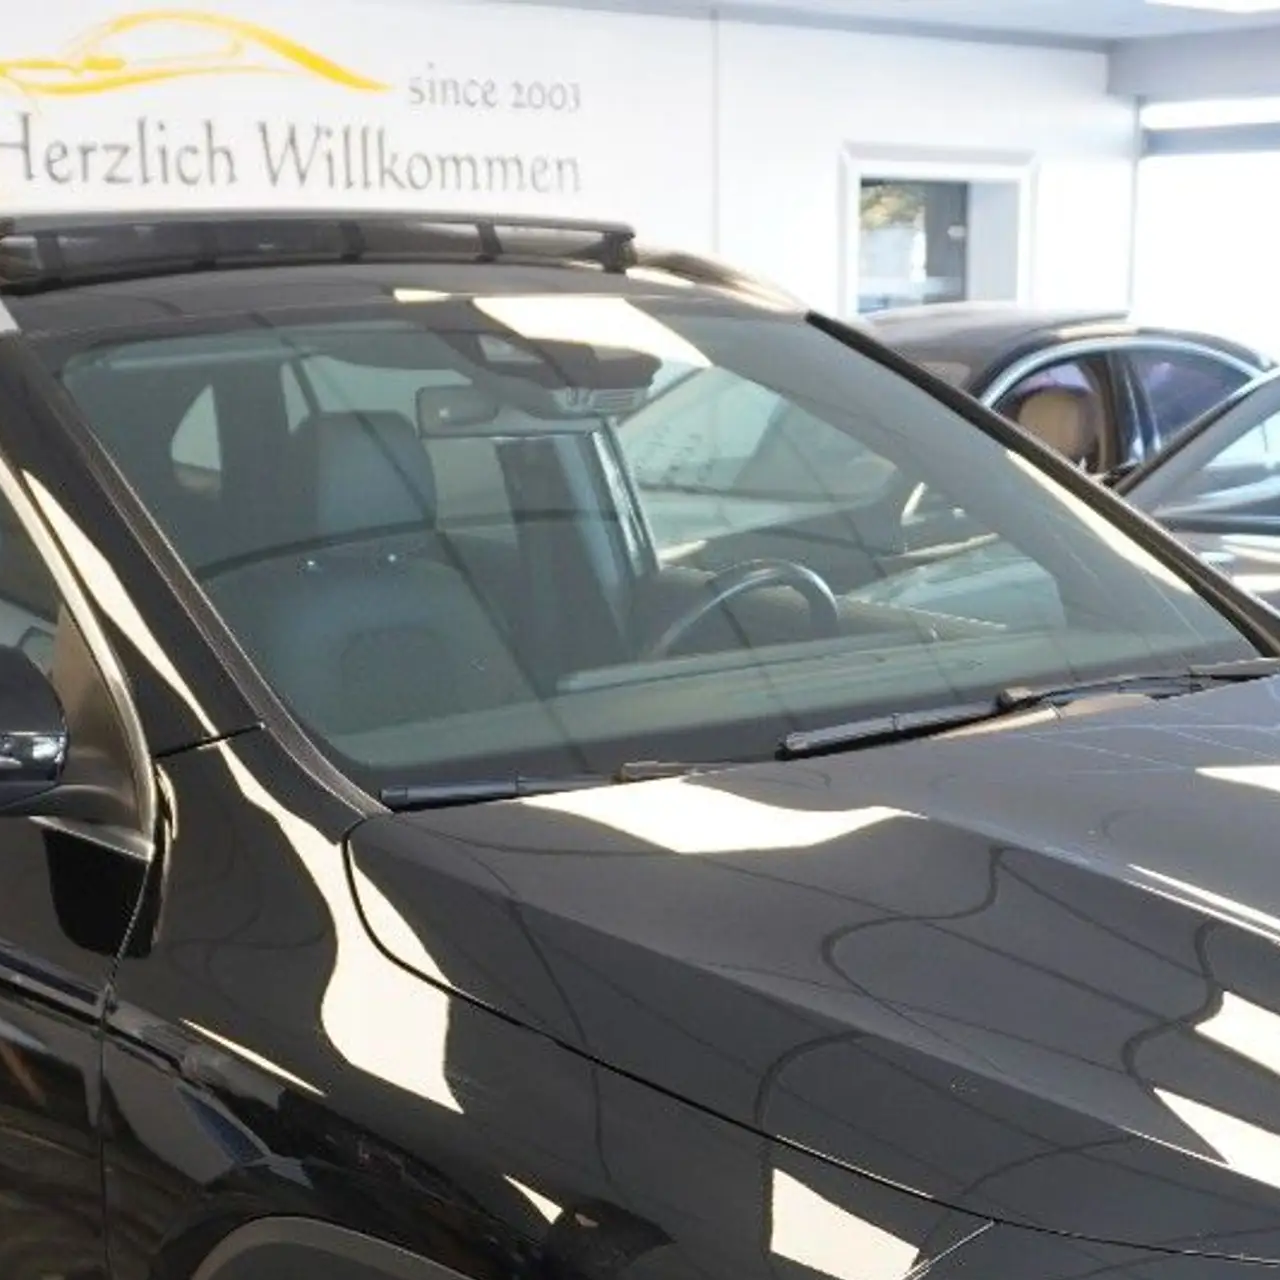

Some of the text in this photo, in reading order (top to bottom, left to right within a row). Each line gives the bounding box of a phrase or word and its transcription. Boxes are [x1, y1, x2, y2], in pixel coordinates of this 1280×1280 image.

[408, 61, 582, 112] since 2003
[257, 119, 583, 193] Willkommen
